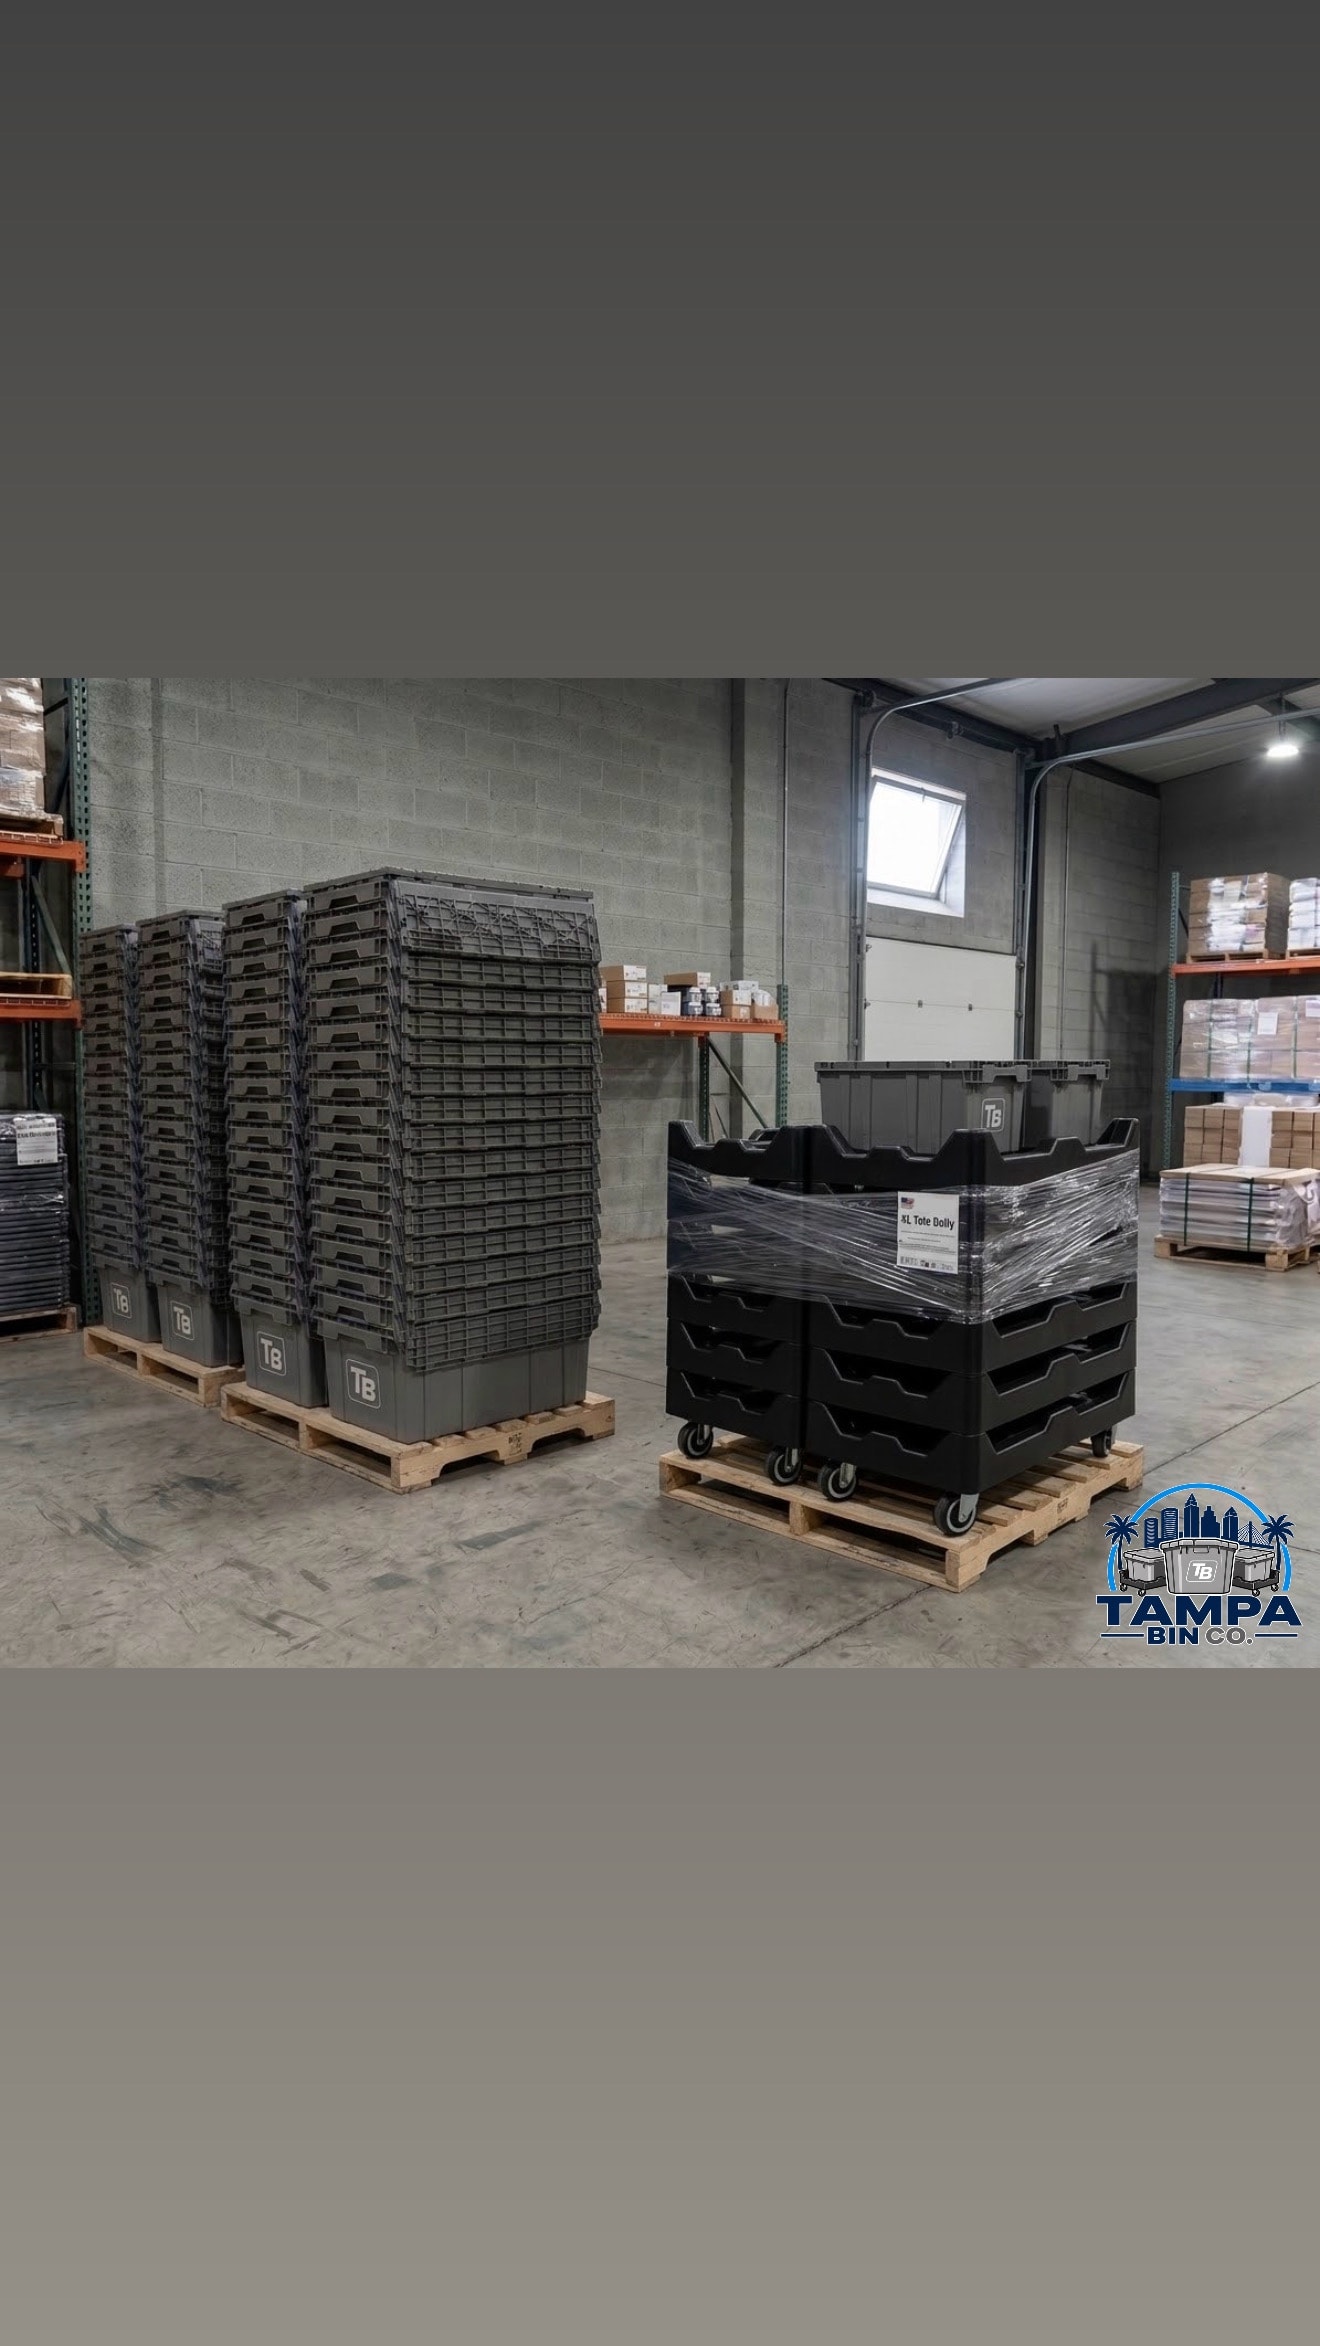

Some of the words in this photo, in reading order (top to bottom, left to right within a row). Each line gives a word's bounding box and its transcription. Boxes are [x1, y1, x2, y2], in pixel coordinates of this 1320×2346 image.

[985, 1104, 1002, 1128] TB
[913, 1215, 931, 1226] Tote
[933, 1217, 955, 1230] Dolly
[114, 1288, 129, 1313] TB
[173, 1306, 191, 1335] TB
[260, 1338, 282, 1371] TB
[350, 1366, 376, 1402] TB
